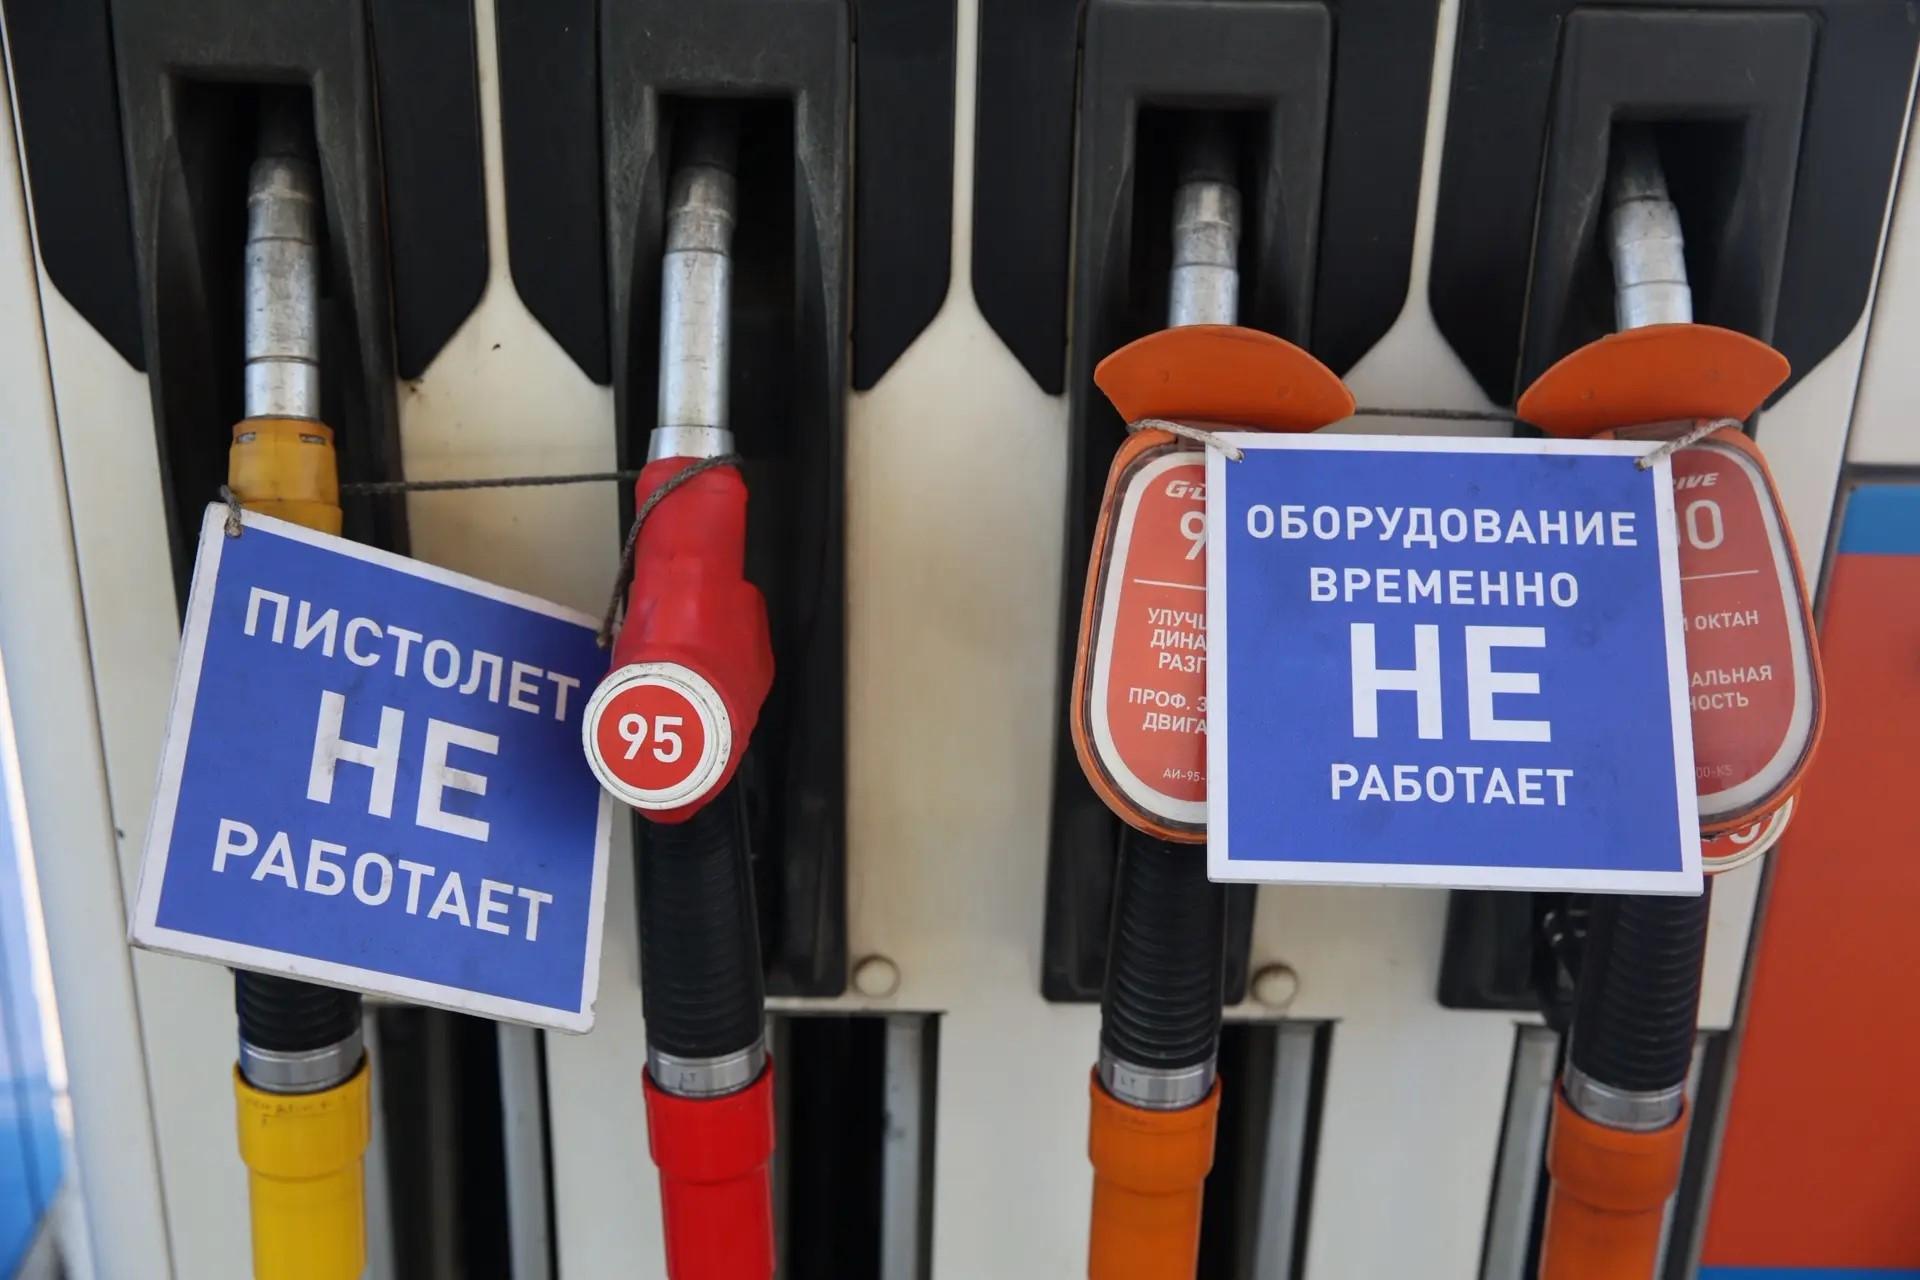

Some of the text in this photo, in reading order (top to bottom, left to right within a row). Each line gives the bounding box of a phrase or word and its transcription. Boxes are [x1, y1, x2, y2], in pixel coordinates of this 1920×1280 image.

[1673, 472, 1720, 491] IVE
[1246, 504, 1638, 549] ОБОРУДОВАНИЕ
[1309, 567, 1579, 608] ВРЕМЕННО
[1695, 610, 1759, 630] ОКТАН
[243, 586, 581, 722] ПИСТОЛЕТ
[1350, 623, 1552, 742] НЕ
[1691, 665, 1773, 688] АЛЬНАЯ
[1128, 687, 1191, 711] ПРОФ.
[618, 713, 683, 763] 95
[306, 690, 500, 842] НЕ
[1330, 763, 1574, 807] РАБОТАЕТ
[211, 818, 553, 942] РАБОТАЕТ
